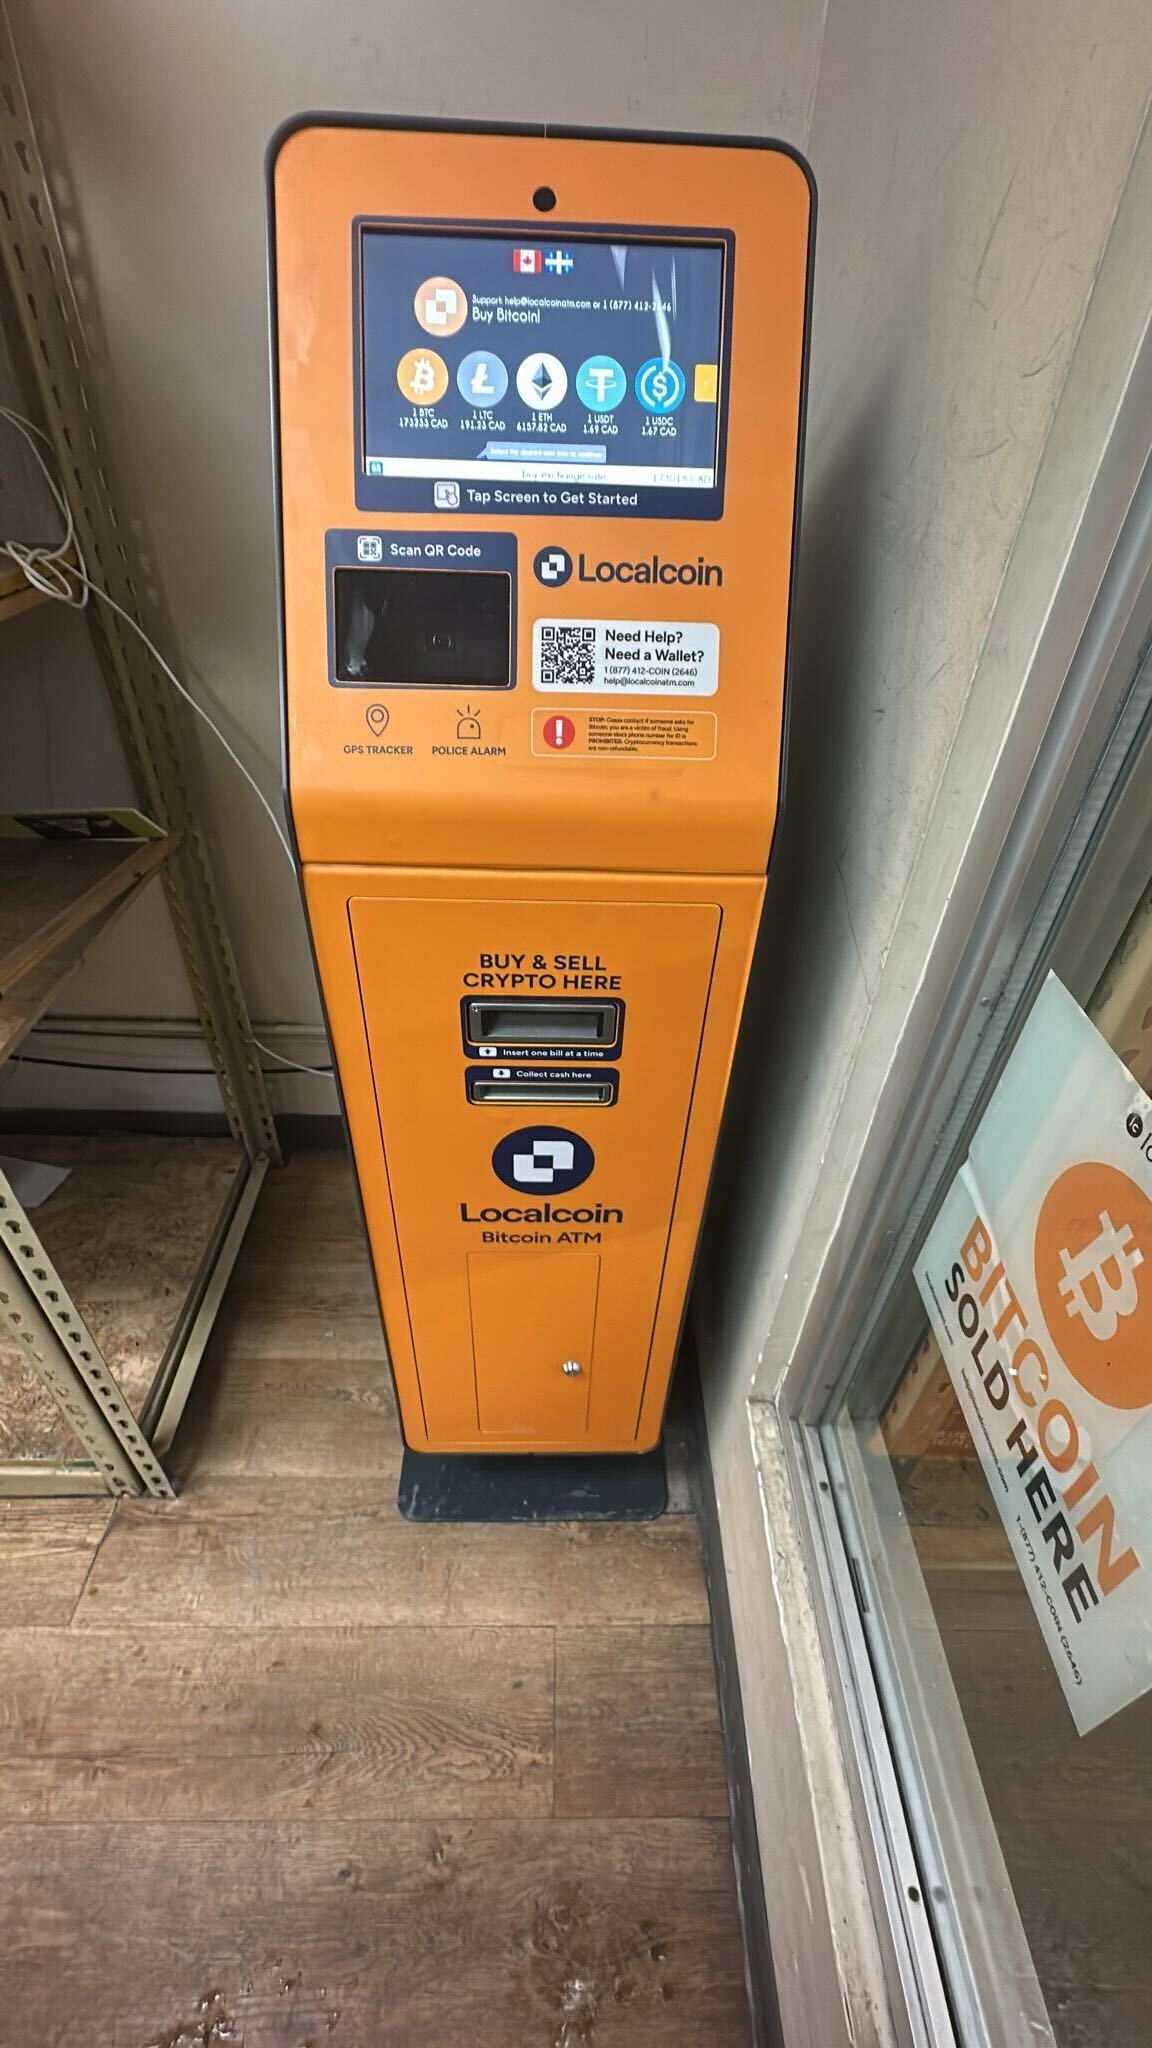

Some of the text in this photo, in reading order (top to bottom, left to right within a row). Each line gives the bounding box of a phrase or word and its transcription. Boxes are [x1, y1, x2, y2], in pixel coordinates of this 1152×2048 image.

[472, 306, 494, 324] Buy
[419, 408, 435, 418] BTC
[479, 410, 494, 421] LTC
[538, 413, 553, 423] ETH
[430, 419, 449, 429] CAD
[594, 415, 614, 425] USDT
[651, 416, 674, 426] USDC
[488, 421, 506, 432] CAD
[550, 423, 567, 433] CAD
[583, 424, 618, 435] 1.69 CAD
[641, 426, 677, 437] 1.67 CAD
[467, 489, 638, 506] Tap Screen to Get Started
[390, 544, 481, 557] Scan QR Code
[578, 554, 723, 586] Localcoin
[605, 629, 683, 646] Need Help?
[605, 647, 705, 662] Need a Wallet?
[610, 666, 630, 675] (877)
[632, 667, 670, 675] 412-COIN
[672, 667, 698, 677] (2646)
[603, 677, 695, 687] help@localcoinatm.com
[343, 745, 413, 755] GPS TRACKER
[432, 746, 506, 755] POLICE ALARM
[479, 953, 607, 971] BUY & SELL
[463, 972, 622, 990] CRYPTO HERE
[503, 1049, 529, 1057] Insert
[549, 1049, 563, 1057] bill
[516, 1070, 547, 1078] Collect
[571, 1071, 592, 1079] here
[460, 1203, 624, 1223] Localcoin
[482, 1231, 602, 1244] Bitcoin ATM
[960, 1215, 1140, 1598] BITCOIN
[945, 1262, 1010, 1411] SOLD
[1006, 1417, 1100, 1624] HERE
[1034, 1564, 1063, 1633] 412-COIN
